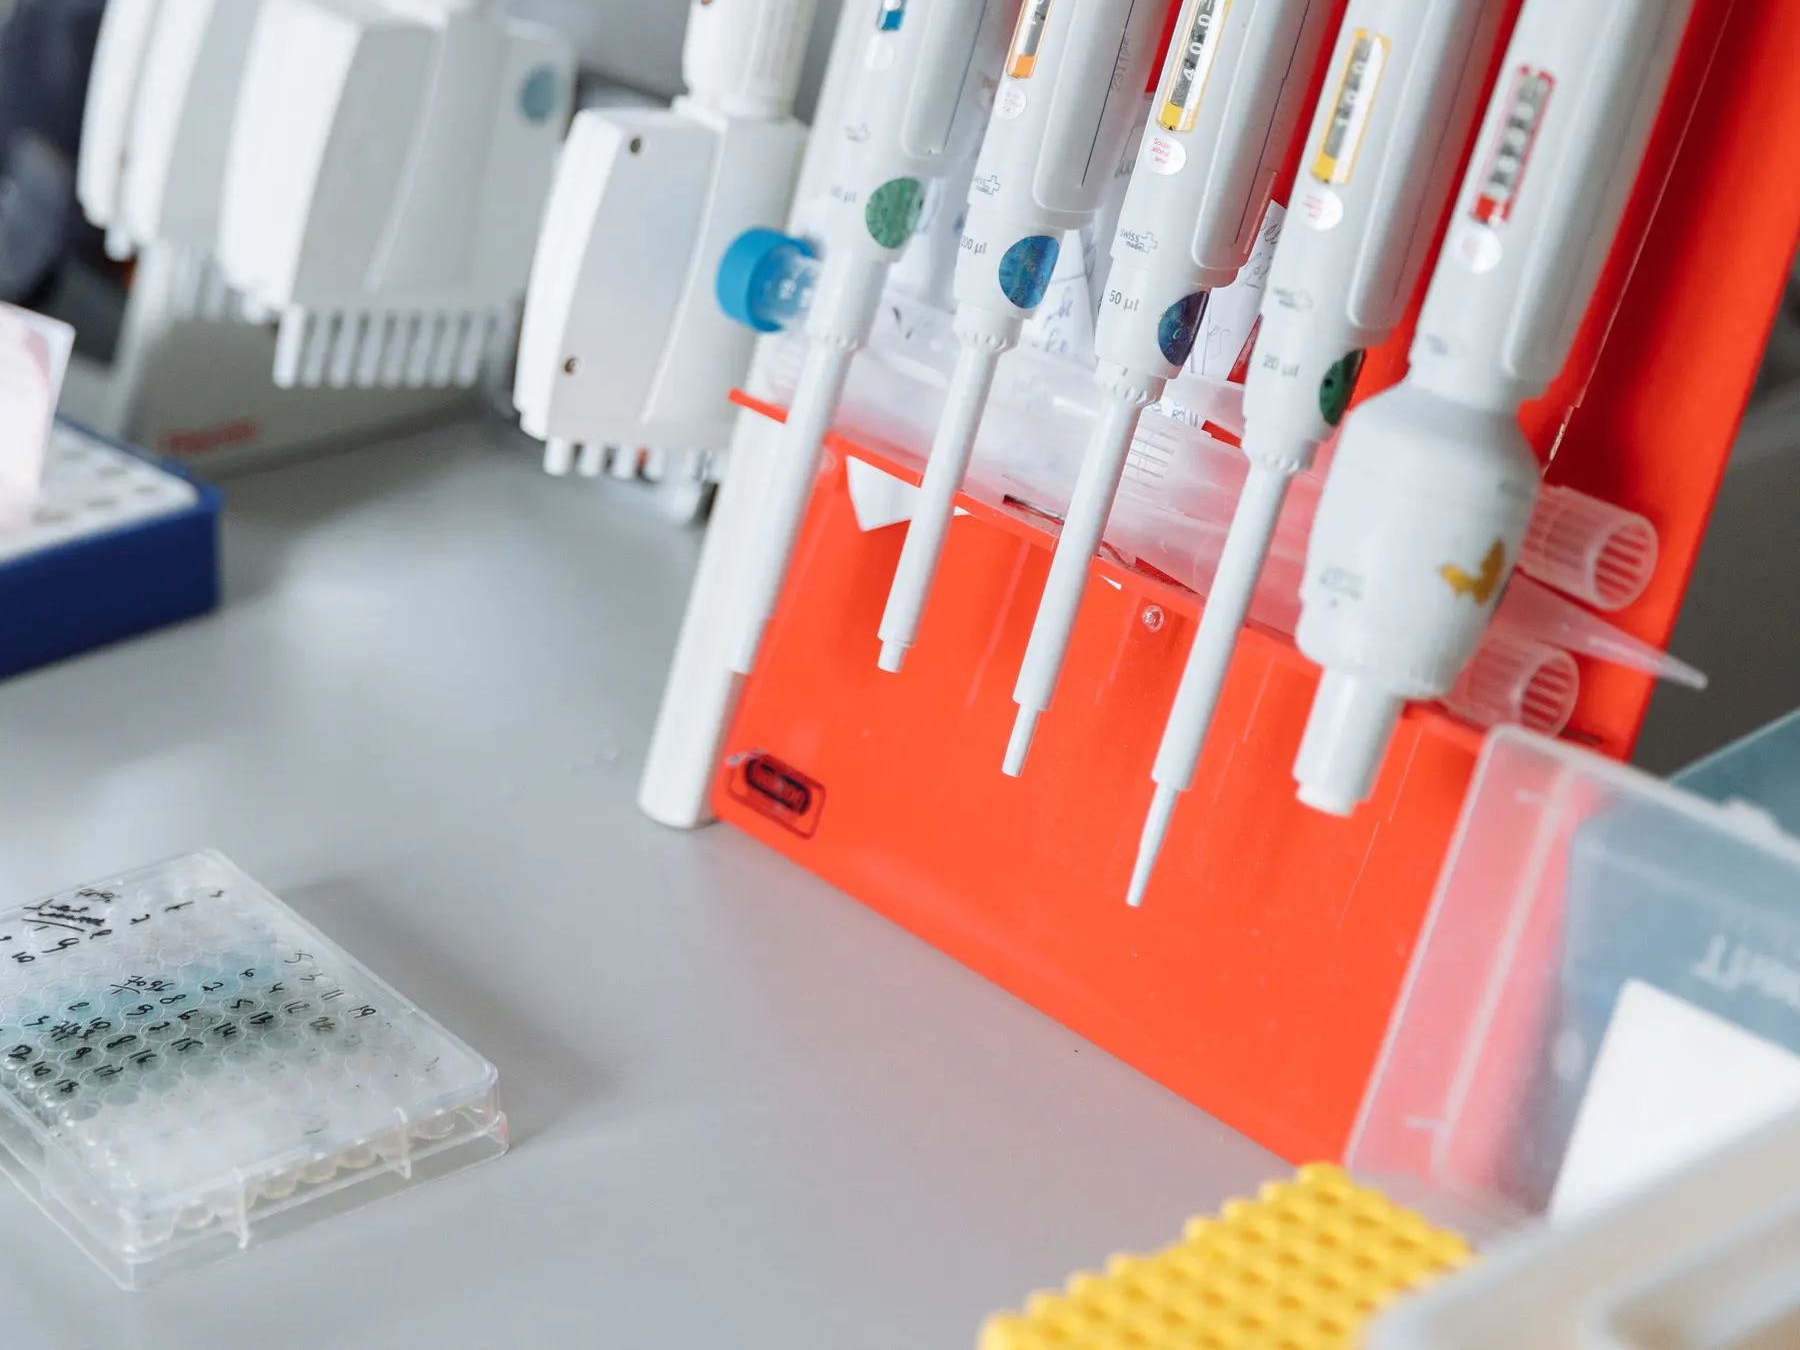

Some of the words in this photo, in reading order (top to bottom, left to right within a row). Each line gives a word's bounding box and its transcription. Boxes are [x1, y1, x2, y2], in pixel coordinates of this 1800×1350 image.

[974, 242, 987, 255] µl
[1109, 290, 1122, 305] 50
[1123, 297, 1140, 311] µl
[41, 937, 80, 954] 9
[11, 951, 36, 964] 10
[239, 967, 257, 978] 6
[268, 981, 285, 995] 4
[159, 993, 188, 1005] 8
[230, 999, 254, 1010] 5
[126, 1004, 155, 1017] 9
[177, 1009, 199, 1021] 6
[90, 1016, 112, 1030] 10
[106, 1034, 138, 1049] 8
[170, 1037, 204, 1052] 15
[70, 1046, 93, 1061] 9
[31, 1060, 53, 1077] 10
